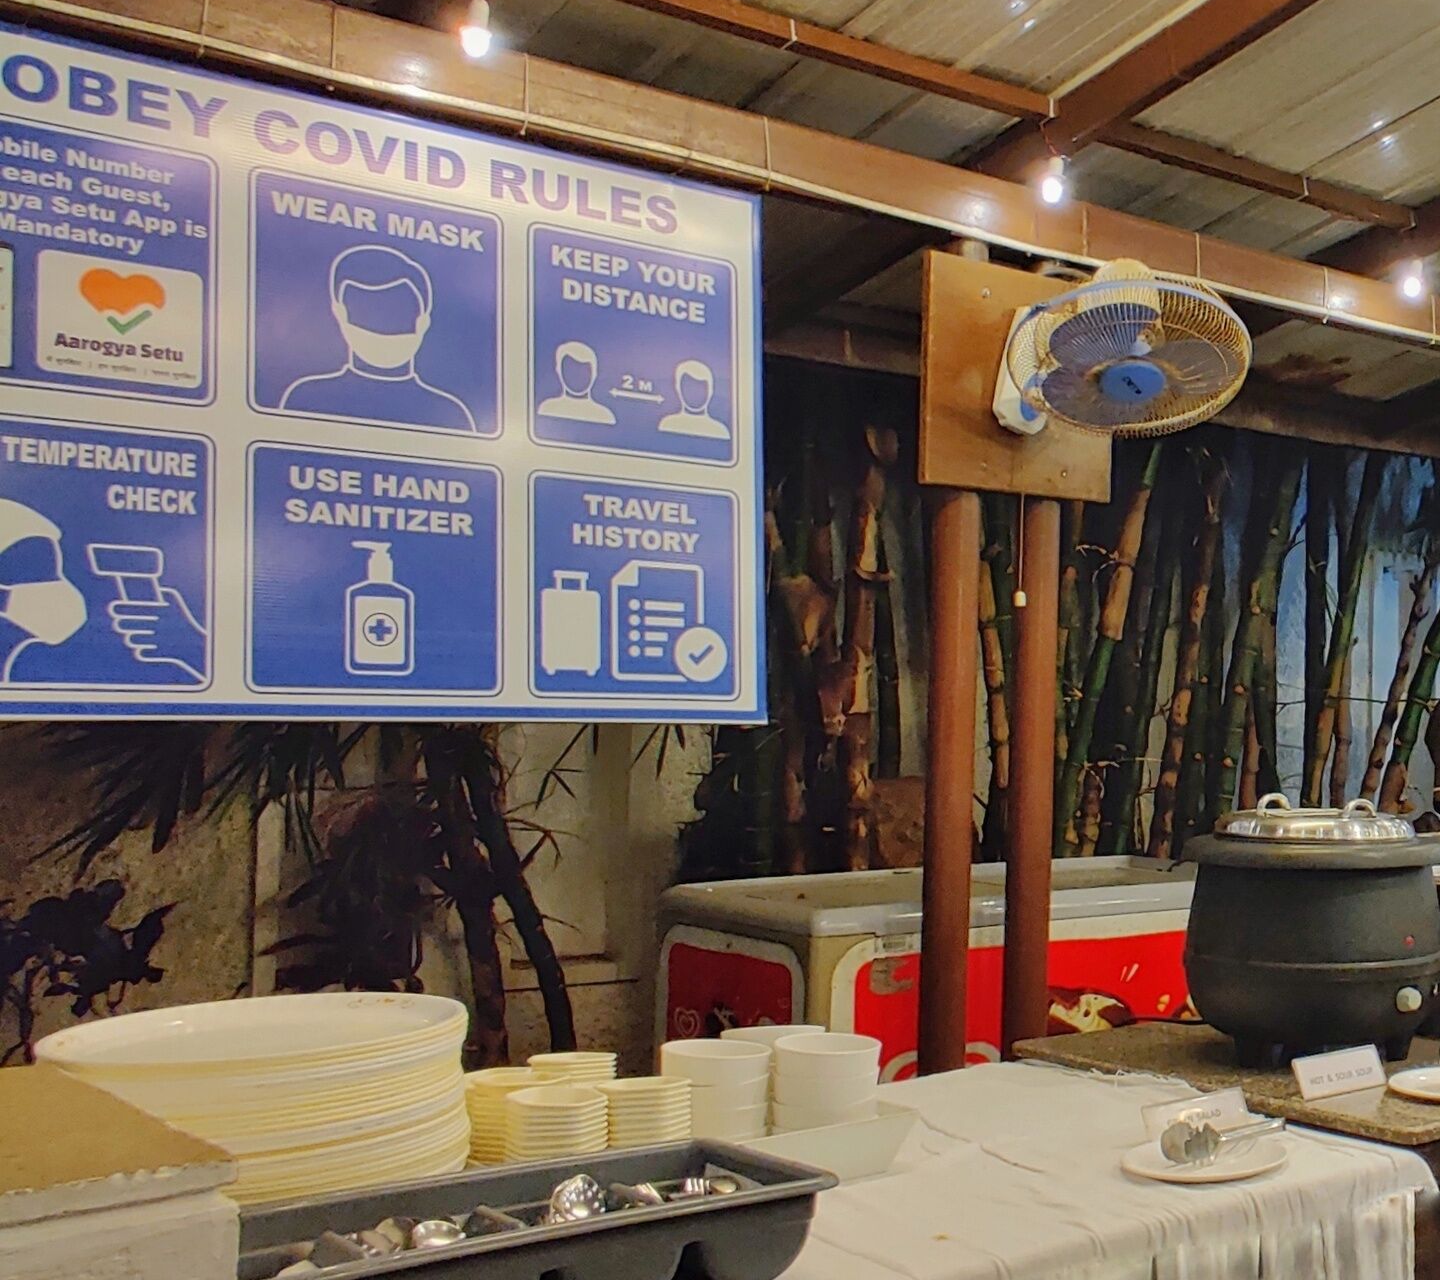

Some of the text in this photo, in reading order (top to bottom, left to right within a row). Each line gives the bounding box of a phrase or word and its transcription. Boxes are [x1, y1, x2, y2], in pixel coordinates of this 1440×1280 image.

[0, 136, 175, 185] bile Number
[2, 54, 678, 234] OBEY COVID RULES
[1, 166, 170, 212] each Guest,
[0, 212, 144, 255] Mandatory
[51, 196, 116, 222] Setu
[124, 209, 177, 236] App
[184, 220, 208, 239] is
[272, 190, 484, 252] WEAR MASK
[551, 244, 716, 296] KEEP YOUR
[562, 278, 706, 324] DISTANCE
[54, 332, 183, 362] Aarogya Setu
[622, 374, 634, 390] 2
[1, 436, 197, 478] TEMPERATURE
[106, 484, 197, 515] CHECK
[289, 465, 470, 504] USE HAND
[284, 498, 474, 536] SANITIZER
[583, 494, 697, 525] TRAVEL
[572, 523, 700, 553] HISTORY
